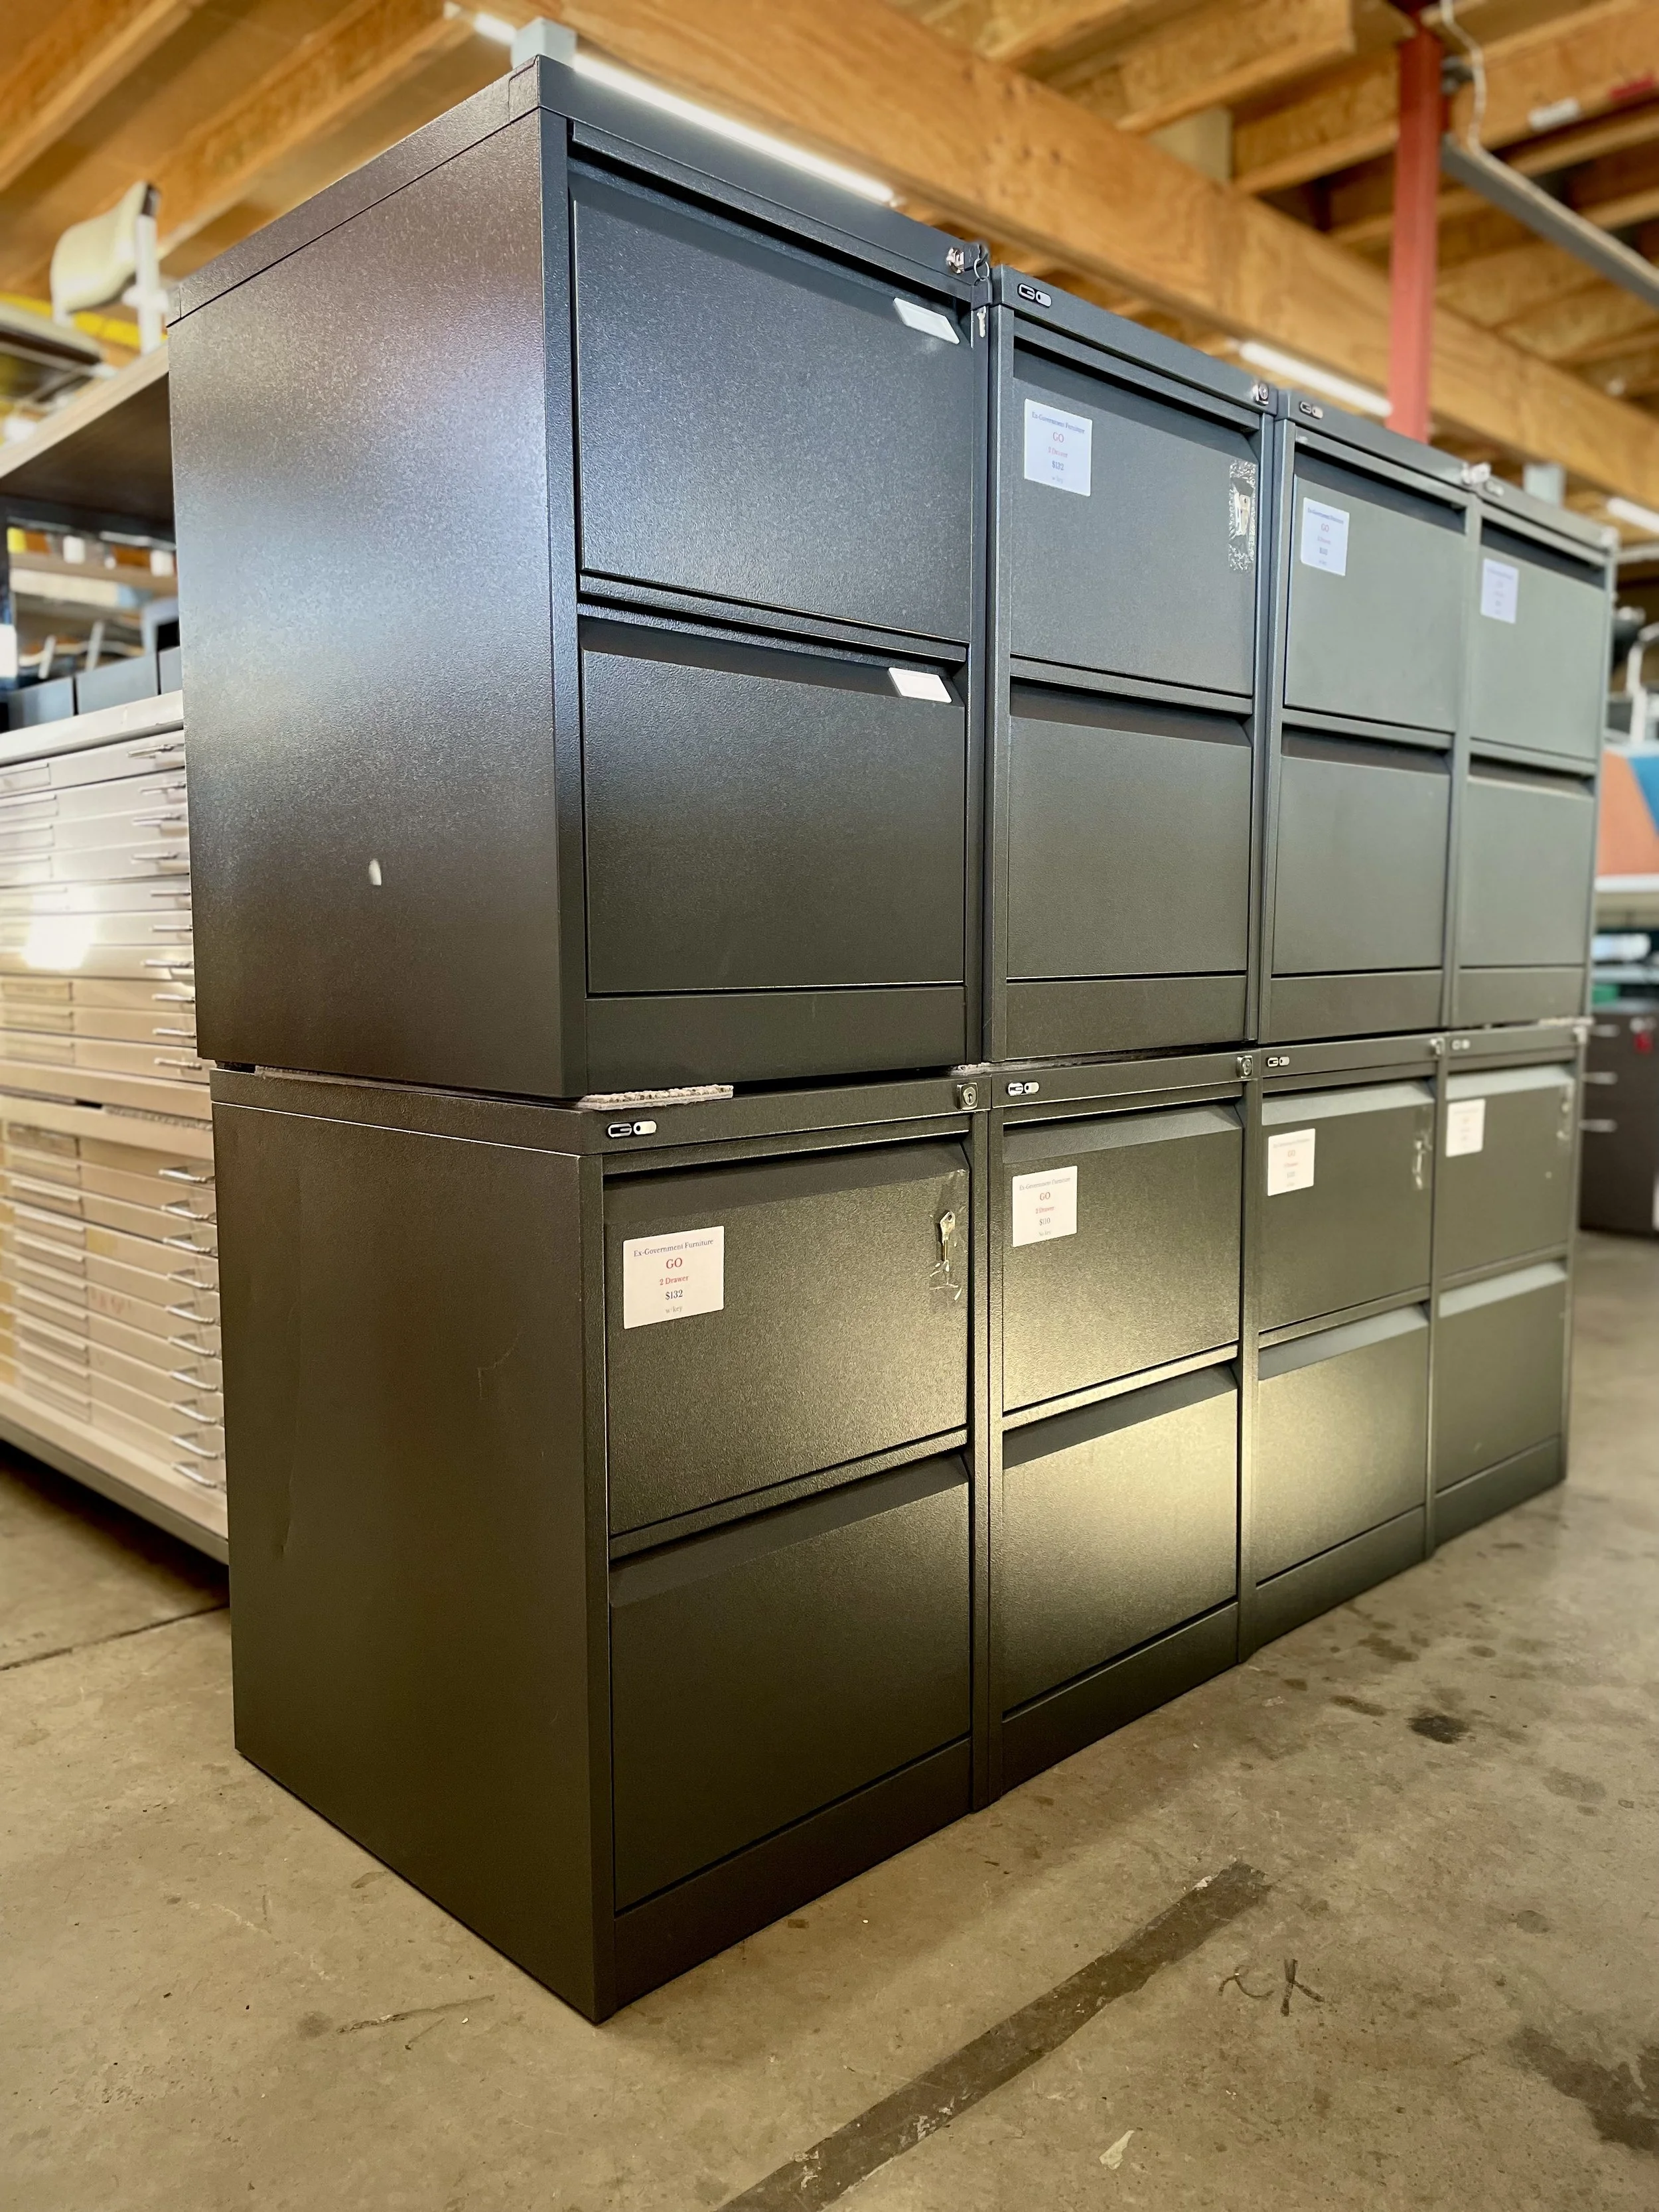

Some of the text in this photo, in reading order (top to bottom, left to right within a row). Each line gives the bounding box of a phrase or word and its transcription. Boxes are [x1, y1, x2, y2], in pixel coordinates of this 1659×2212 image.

[1052, 431, 1064, 443] GO
[1039, 1191, 1050, 1201] GO
[634, 1238, 713, 1257] Ex-Government Furniture
[666, 1258, 683, 1269] GO
[665, 1275, 689, 1285] Drawer
[665, 1290, 684, 1300] $132
